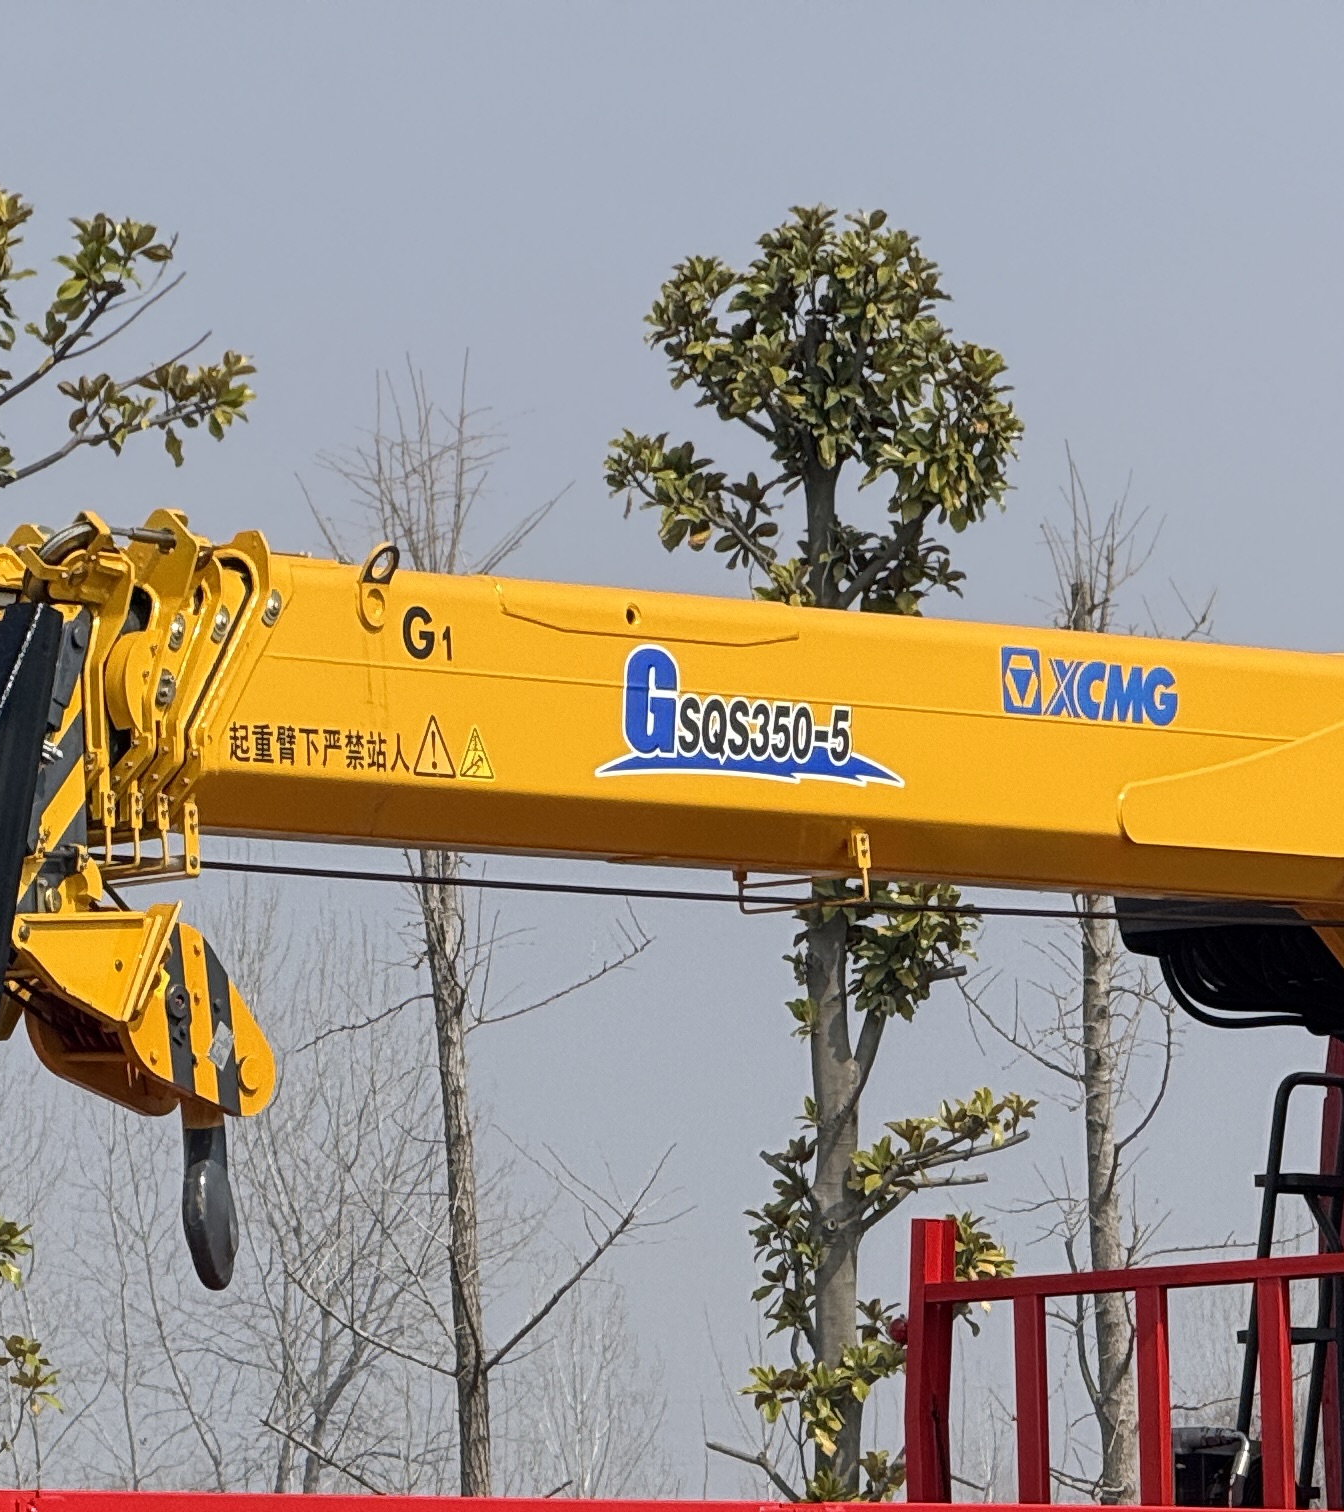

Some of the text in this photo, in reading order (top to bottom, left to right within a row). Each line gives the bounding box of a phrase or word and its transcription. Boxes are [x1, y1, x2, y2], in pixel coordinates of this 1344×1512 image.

[402, 605, 453, 662] G1
[1042, 657, 1178, 726] XCMG
[229, 721, 411, 773] 起重臂下严禁站人
